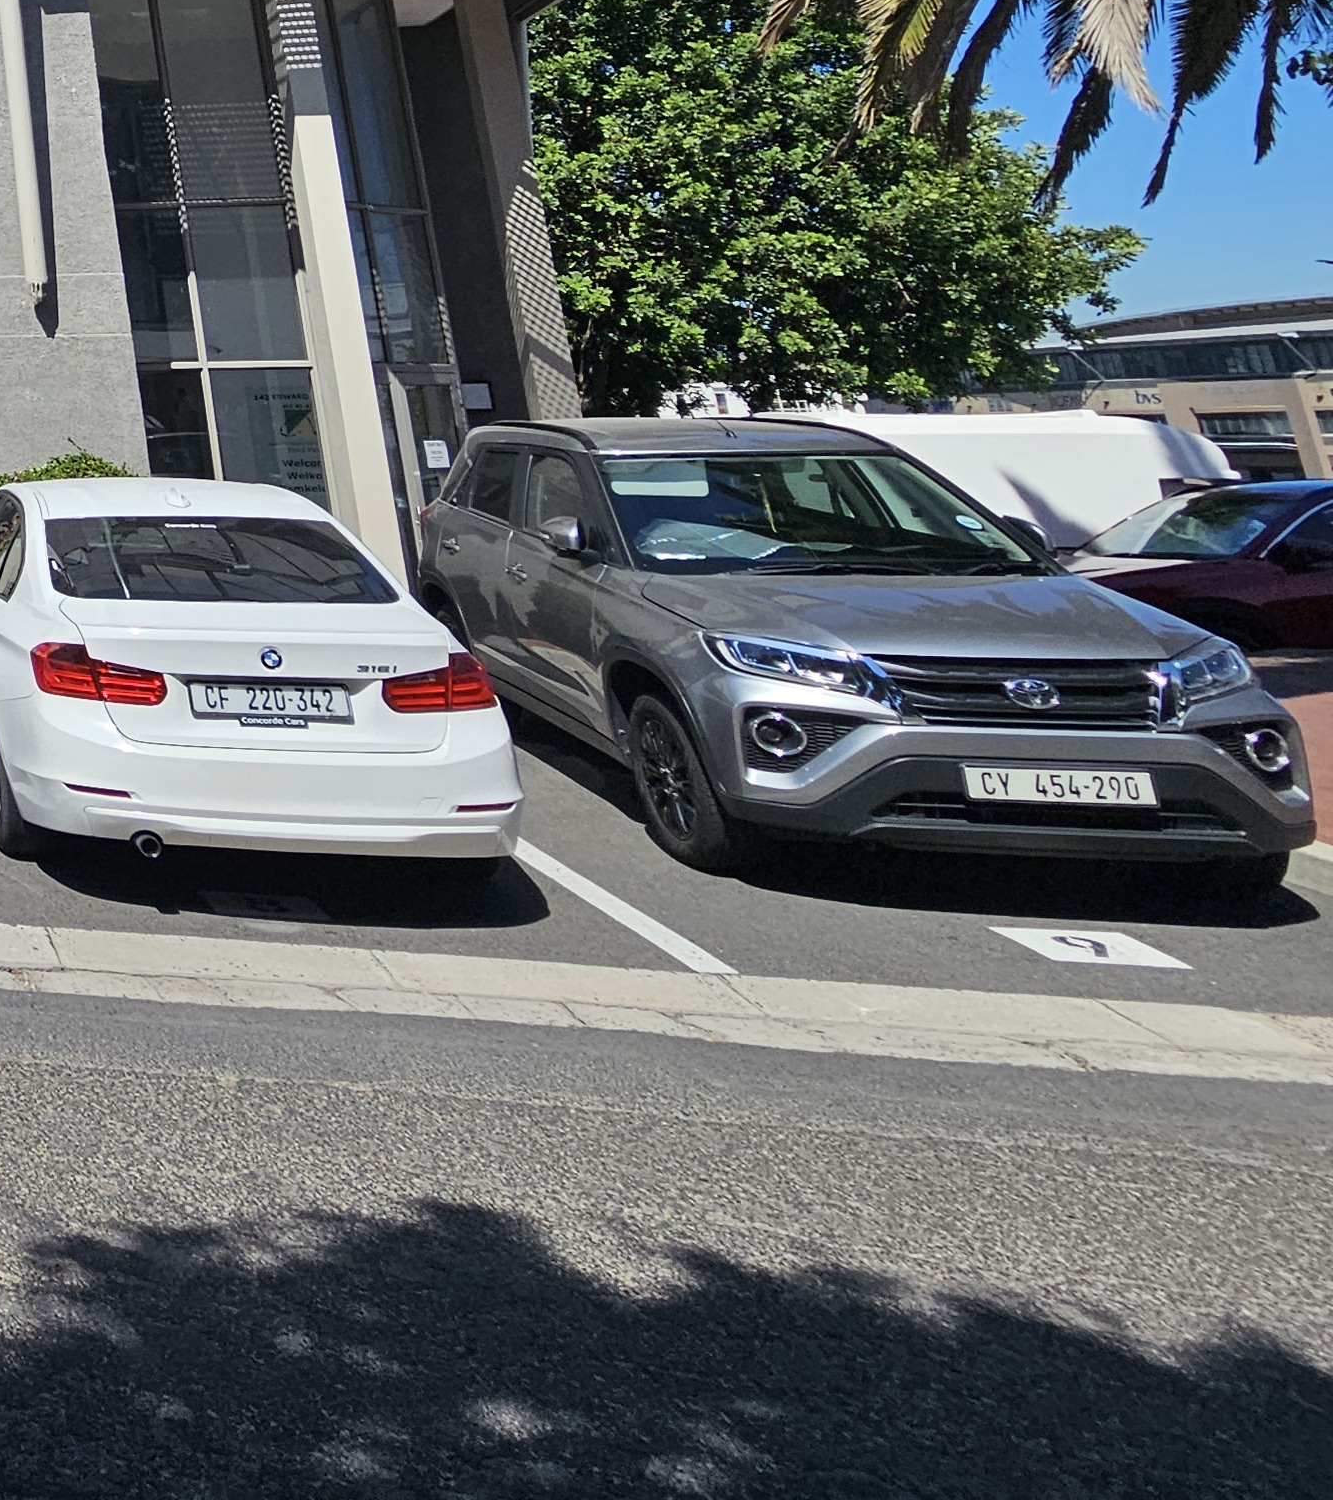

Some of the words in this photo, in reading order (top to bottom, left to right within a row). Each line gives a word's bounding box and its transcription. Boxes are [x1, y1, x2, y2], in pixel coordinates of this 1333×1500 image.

[204, 685, 229, 710] CF
[246, 686, 334, 713] 220-342
[240, 716, 284, 726] Concorde
[285, 717, 305, 726] Cars
[981, 771, 1010, 797] CY
[1035, 773, 1141, 801] 454-290
[1051, 935, 1110, 958] 9
